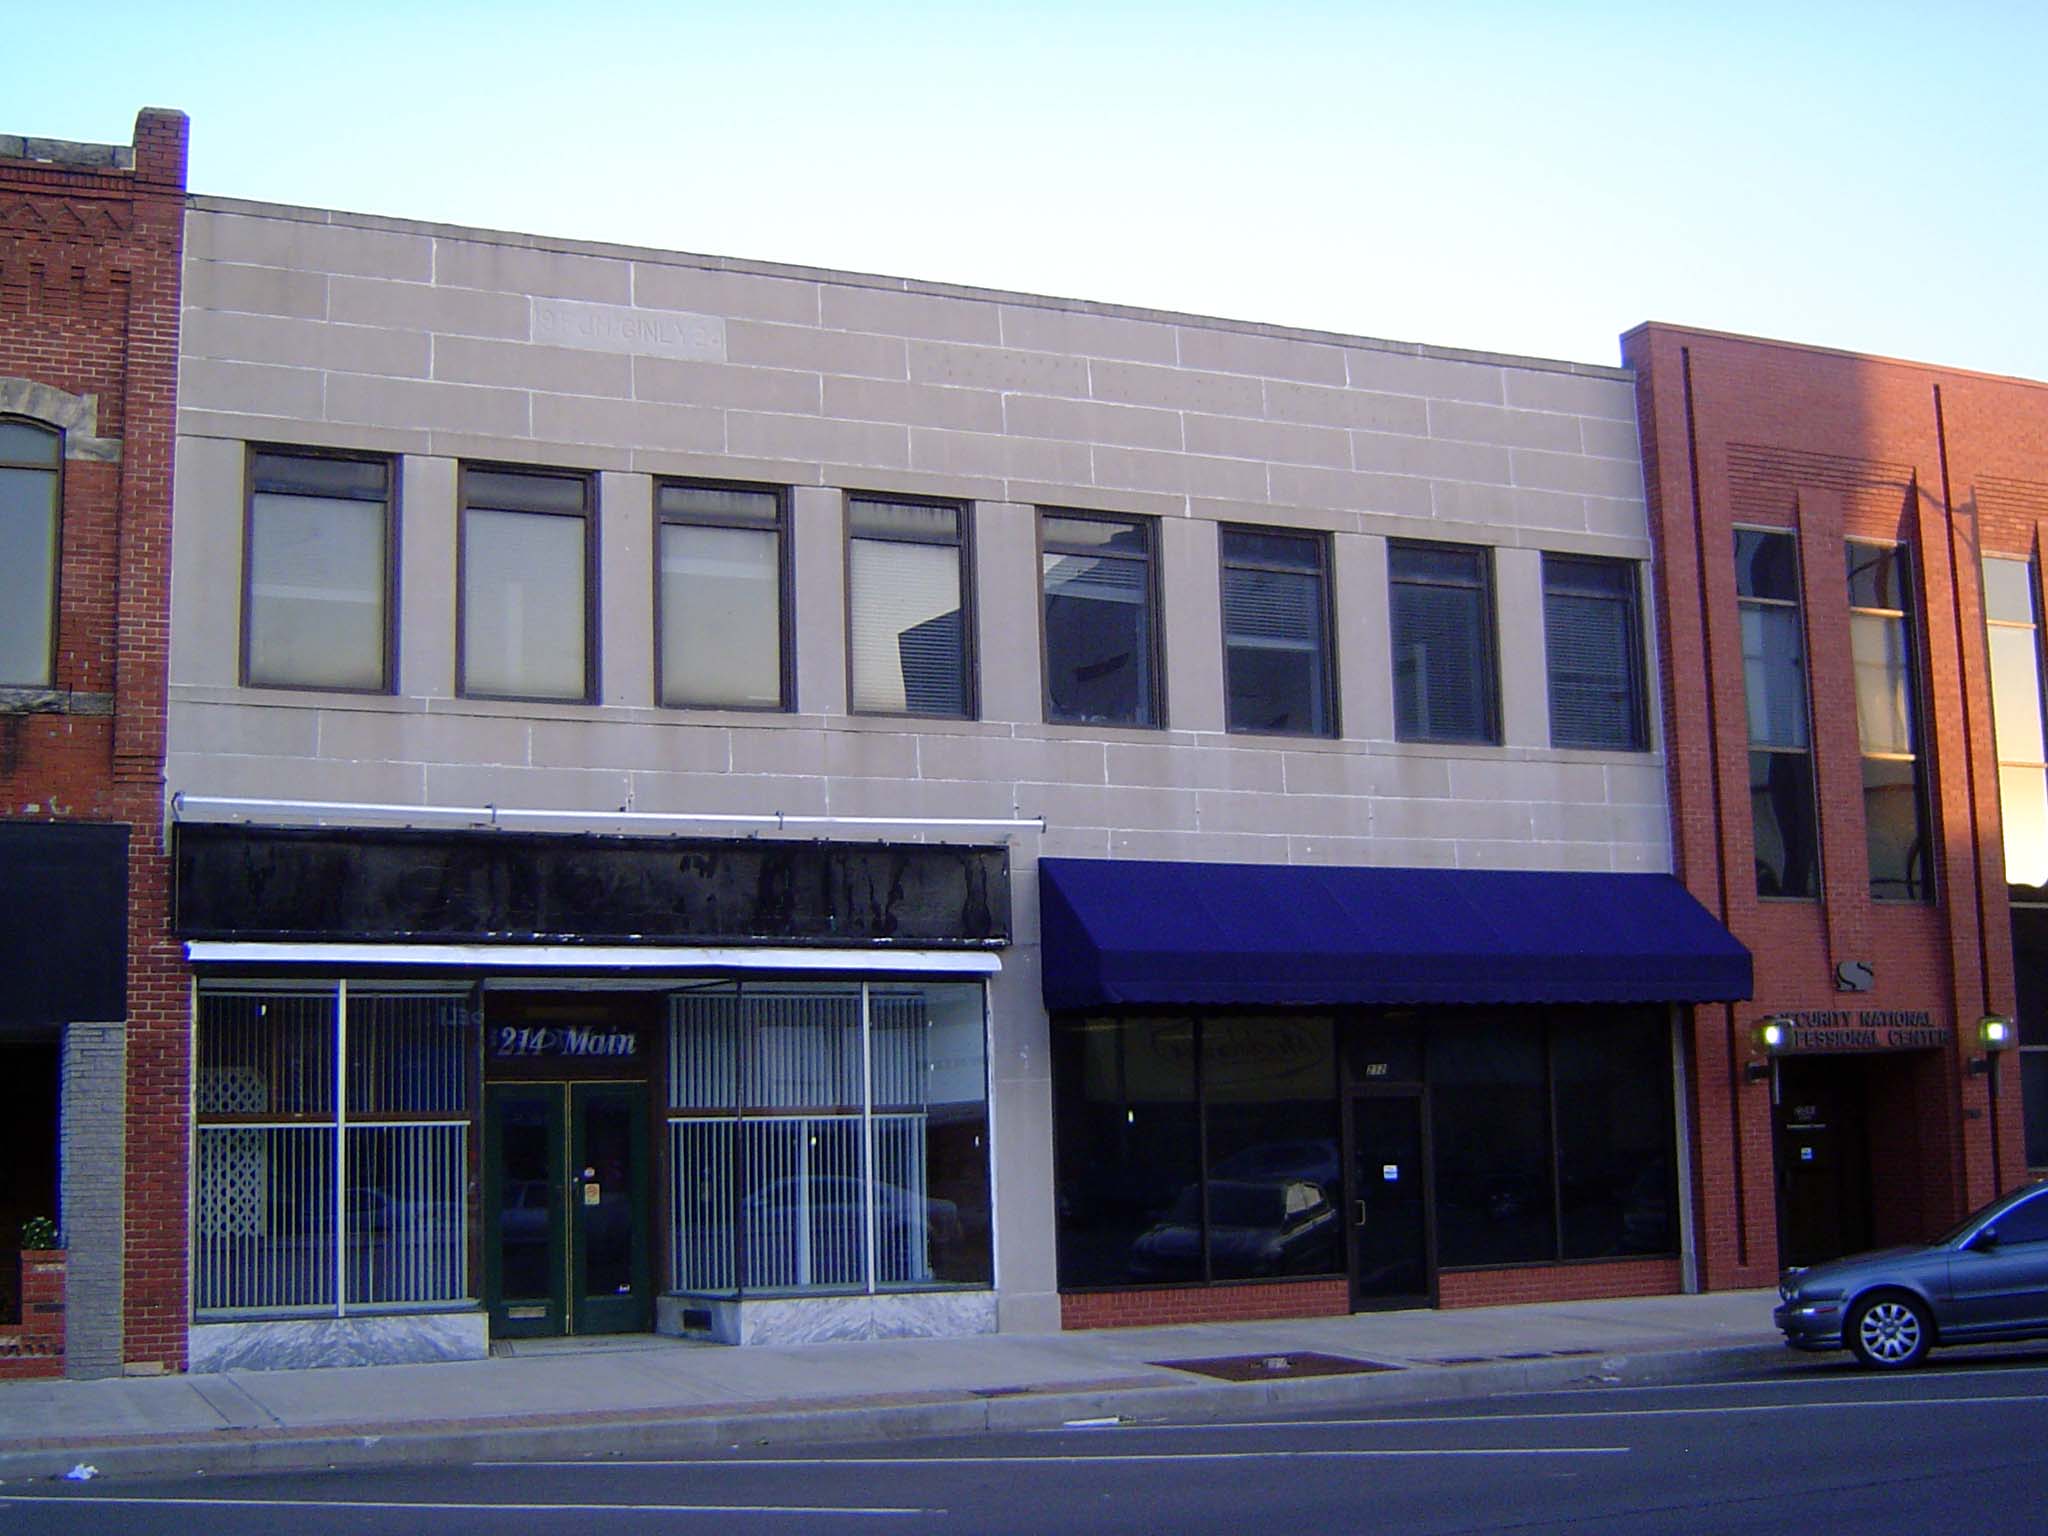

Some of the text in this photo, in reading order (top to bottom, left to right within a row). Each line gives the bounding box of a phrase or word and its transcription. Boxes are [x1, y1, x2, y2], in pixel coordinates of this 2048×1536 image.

[1859, 1010, 1935, 1028] NATIONAL
[498, 1025, 636, 1055] 214 Main
